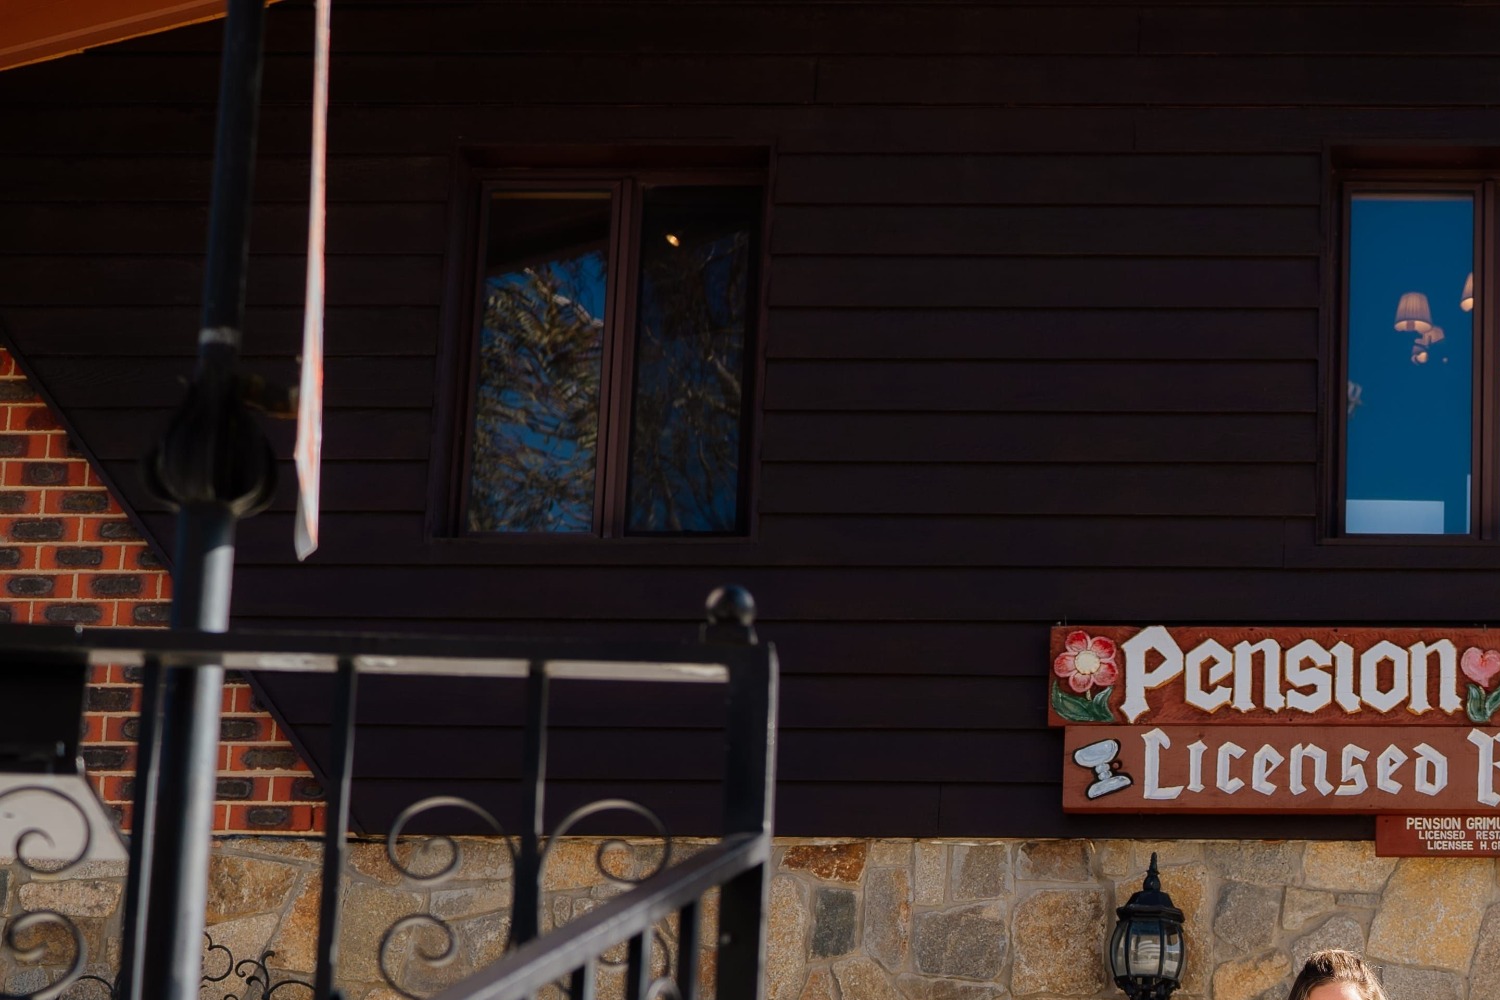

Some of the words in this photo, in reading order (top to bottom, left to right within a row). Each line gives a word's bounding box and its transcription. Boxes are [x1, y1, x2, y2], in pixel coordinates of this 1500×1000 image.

[1119, 625, 1463, 723] Pension
[1140, 727, 1449, 800] Licensed
[1405, 817, 1462, 830] PENSION
[1418, 830, 1466, 840] LICENSED
[1427, 840, 1474, 850] LICENSEE
